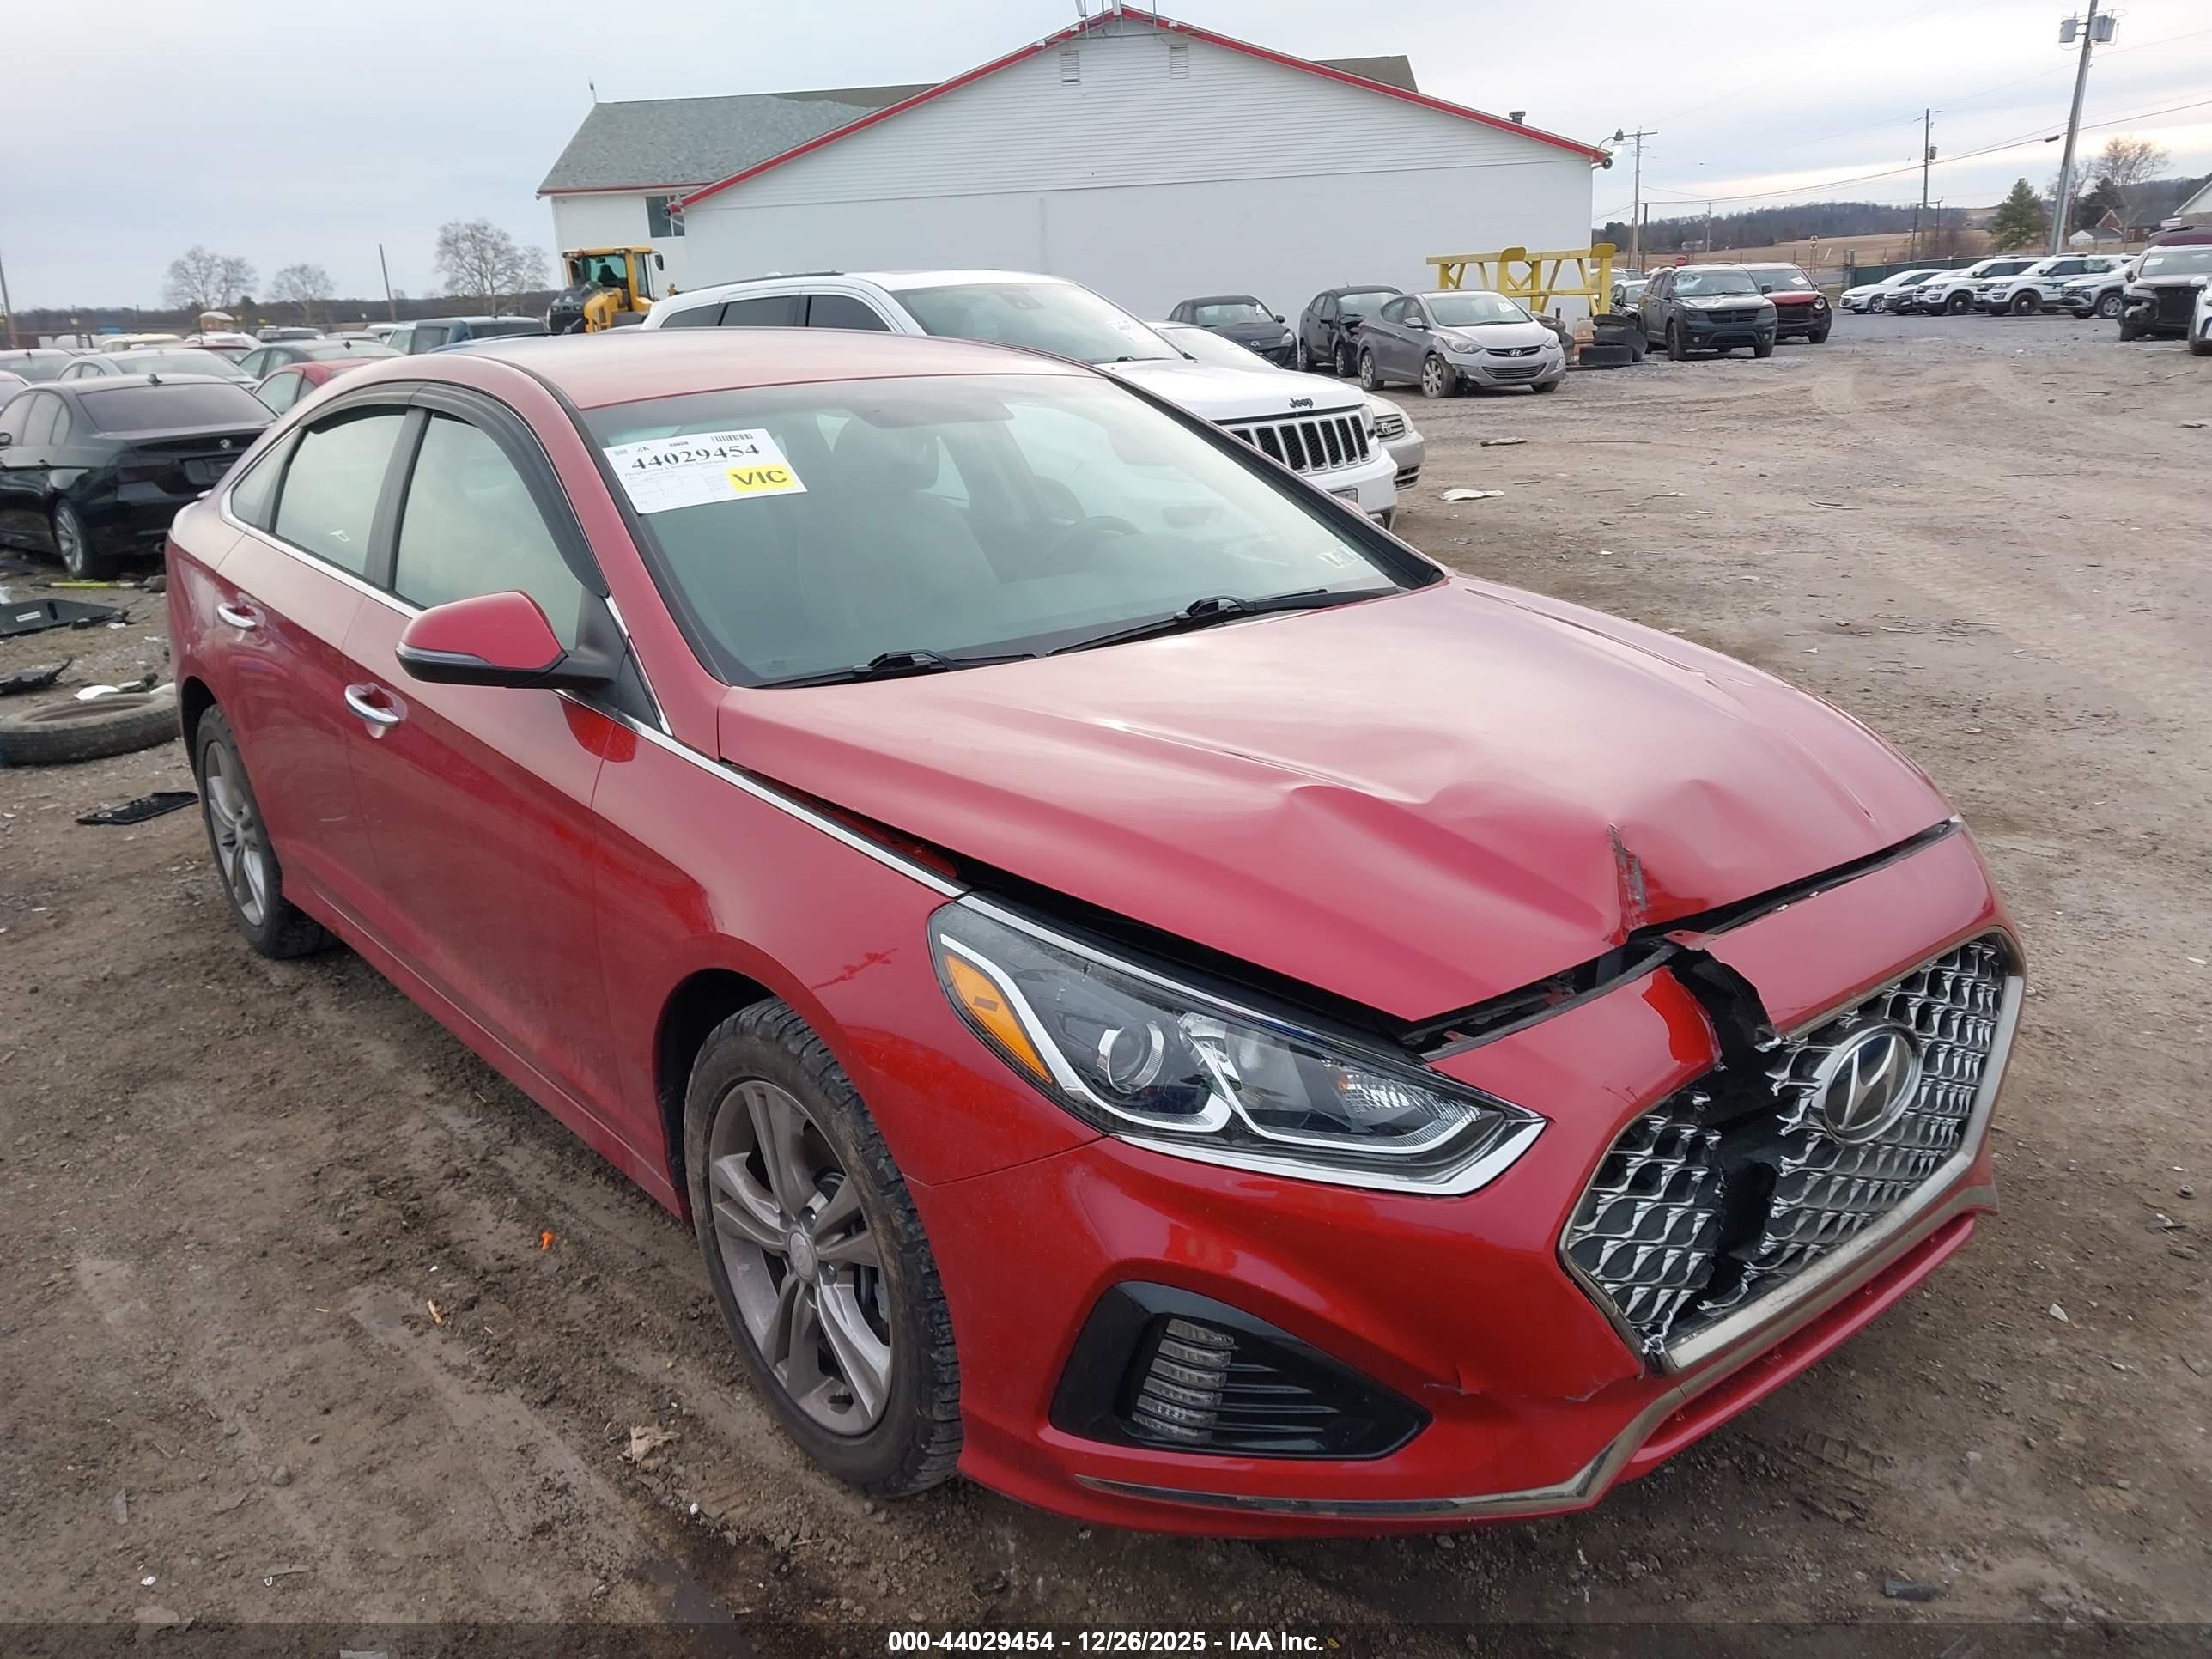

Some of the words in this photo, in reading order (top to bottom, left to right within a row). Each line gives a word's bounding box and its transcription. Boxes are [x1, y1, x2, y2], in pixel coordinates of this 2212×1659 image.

[1289, 398, 1314, 409] Jeep
[631, 444, 760, 470] 44029454
[732, 470, 788, 486] VIC
